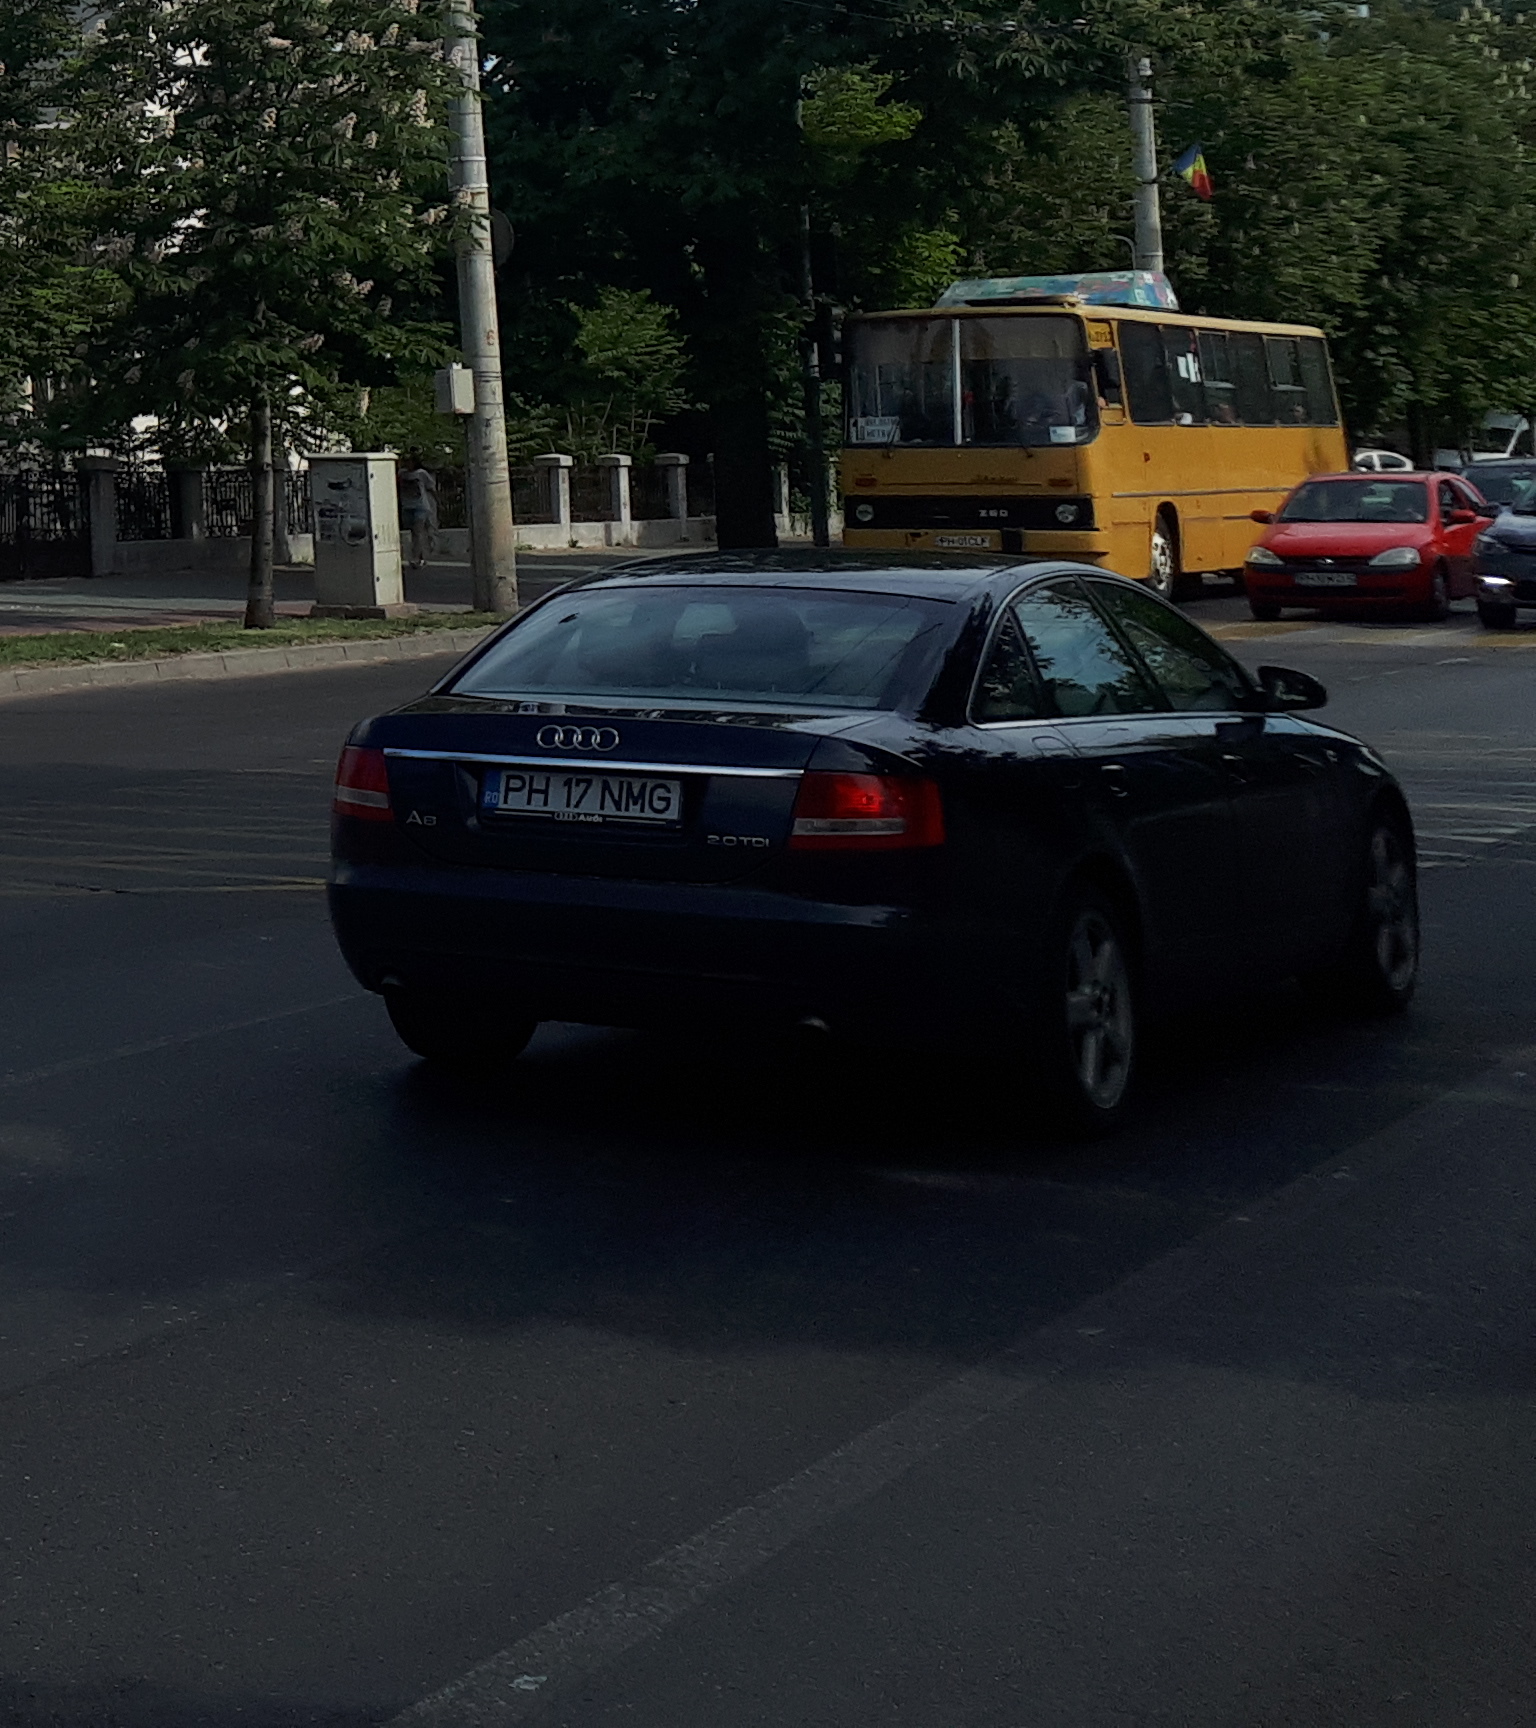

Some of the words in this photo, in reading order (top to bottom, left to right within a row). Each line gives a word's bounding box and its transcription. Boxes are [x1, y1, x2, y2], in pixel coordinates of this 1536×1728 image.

[503, 774, 550, 807] PH
[563, 777, 593, 809] 17
[599, 778, 672, 814] NMG
[578, 814, 603, 823] Audi
